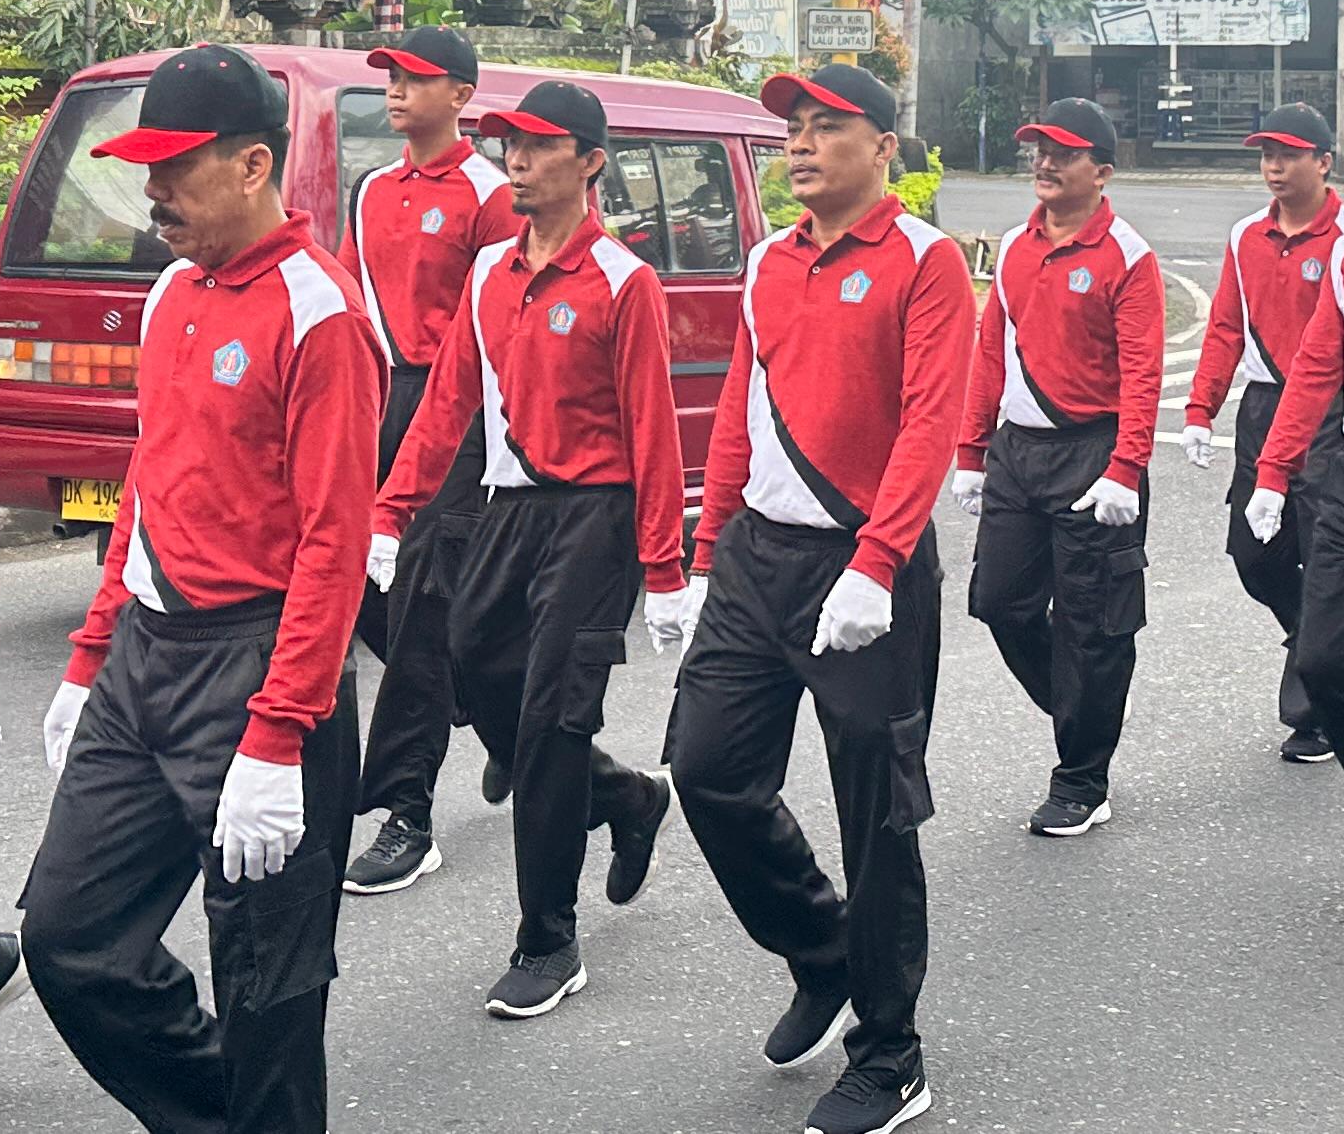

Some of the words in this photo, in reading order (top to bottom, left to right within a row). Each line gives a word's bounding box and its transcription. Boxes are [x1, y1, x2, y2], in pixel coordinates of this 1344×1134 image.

[816, 15, 843, 24] BELOK
[848, 16, 864, 24] KIRI
[812, 36, 834, 45] LALU
[838, 36, 867, 46] LINTAS
[64, 480, 83, 504] DK
